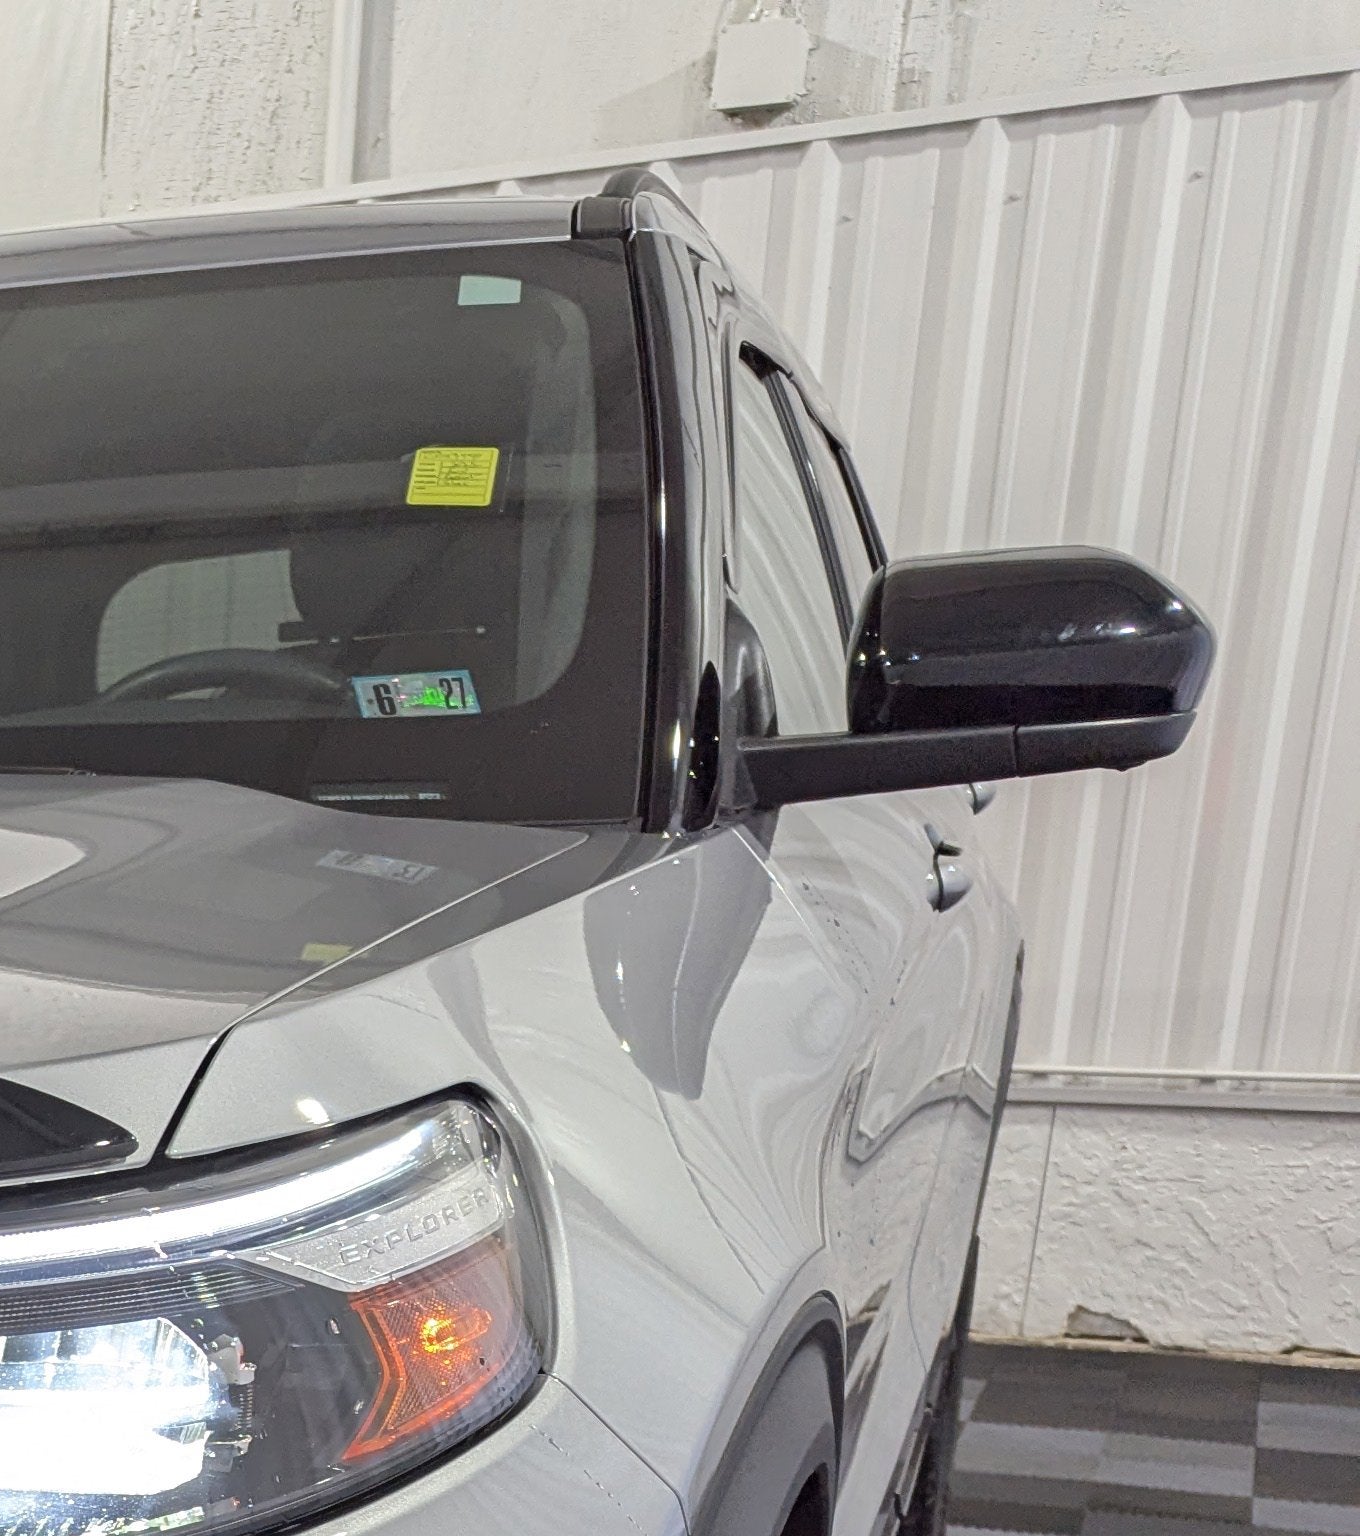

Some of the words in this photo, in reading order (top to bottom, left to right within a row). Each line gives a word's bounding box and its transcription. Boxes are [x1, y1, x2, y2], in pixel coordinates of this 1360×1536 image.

[372, 683, 397, 716] 6
[438, 677, 467, 709] 27
[338, 1188, 489, 1266] EXPLORER
